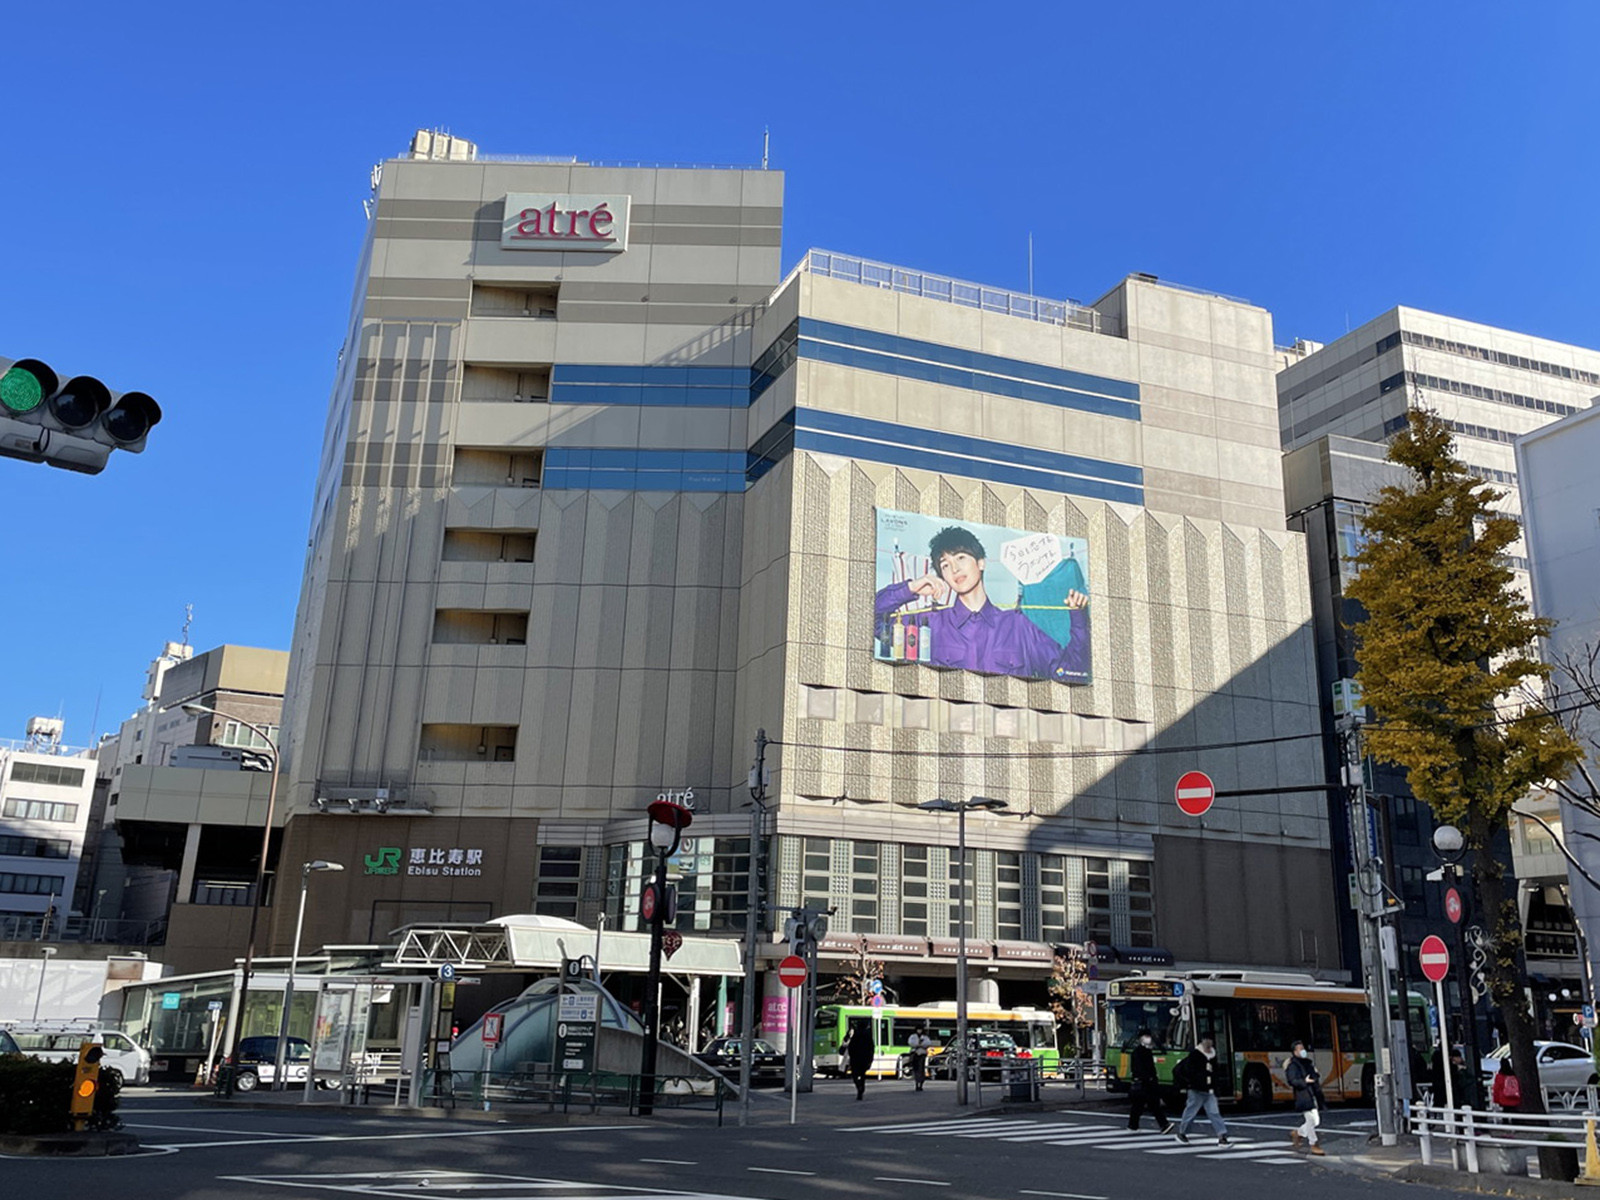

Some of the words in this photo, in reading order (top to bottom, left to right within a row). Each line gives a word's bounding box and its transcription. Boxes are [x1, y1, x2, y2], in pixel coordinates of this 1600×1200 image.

[517, 201, 613, 237] atré
[364, 847, 402, 867] JR
[409, 848, 483, 865] 恵比寿駅
[407, 865, 439, 876] Ebisu
[442, 866, 481, 876] Station
[443, 965, 452, 978] 3
